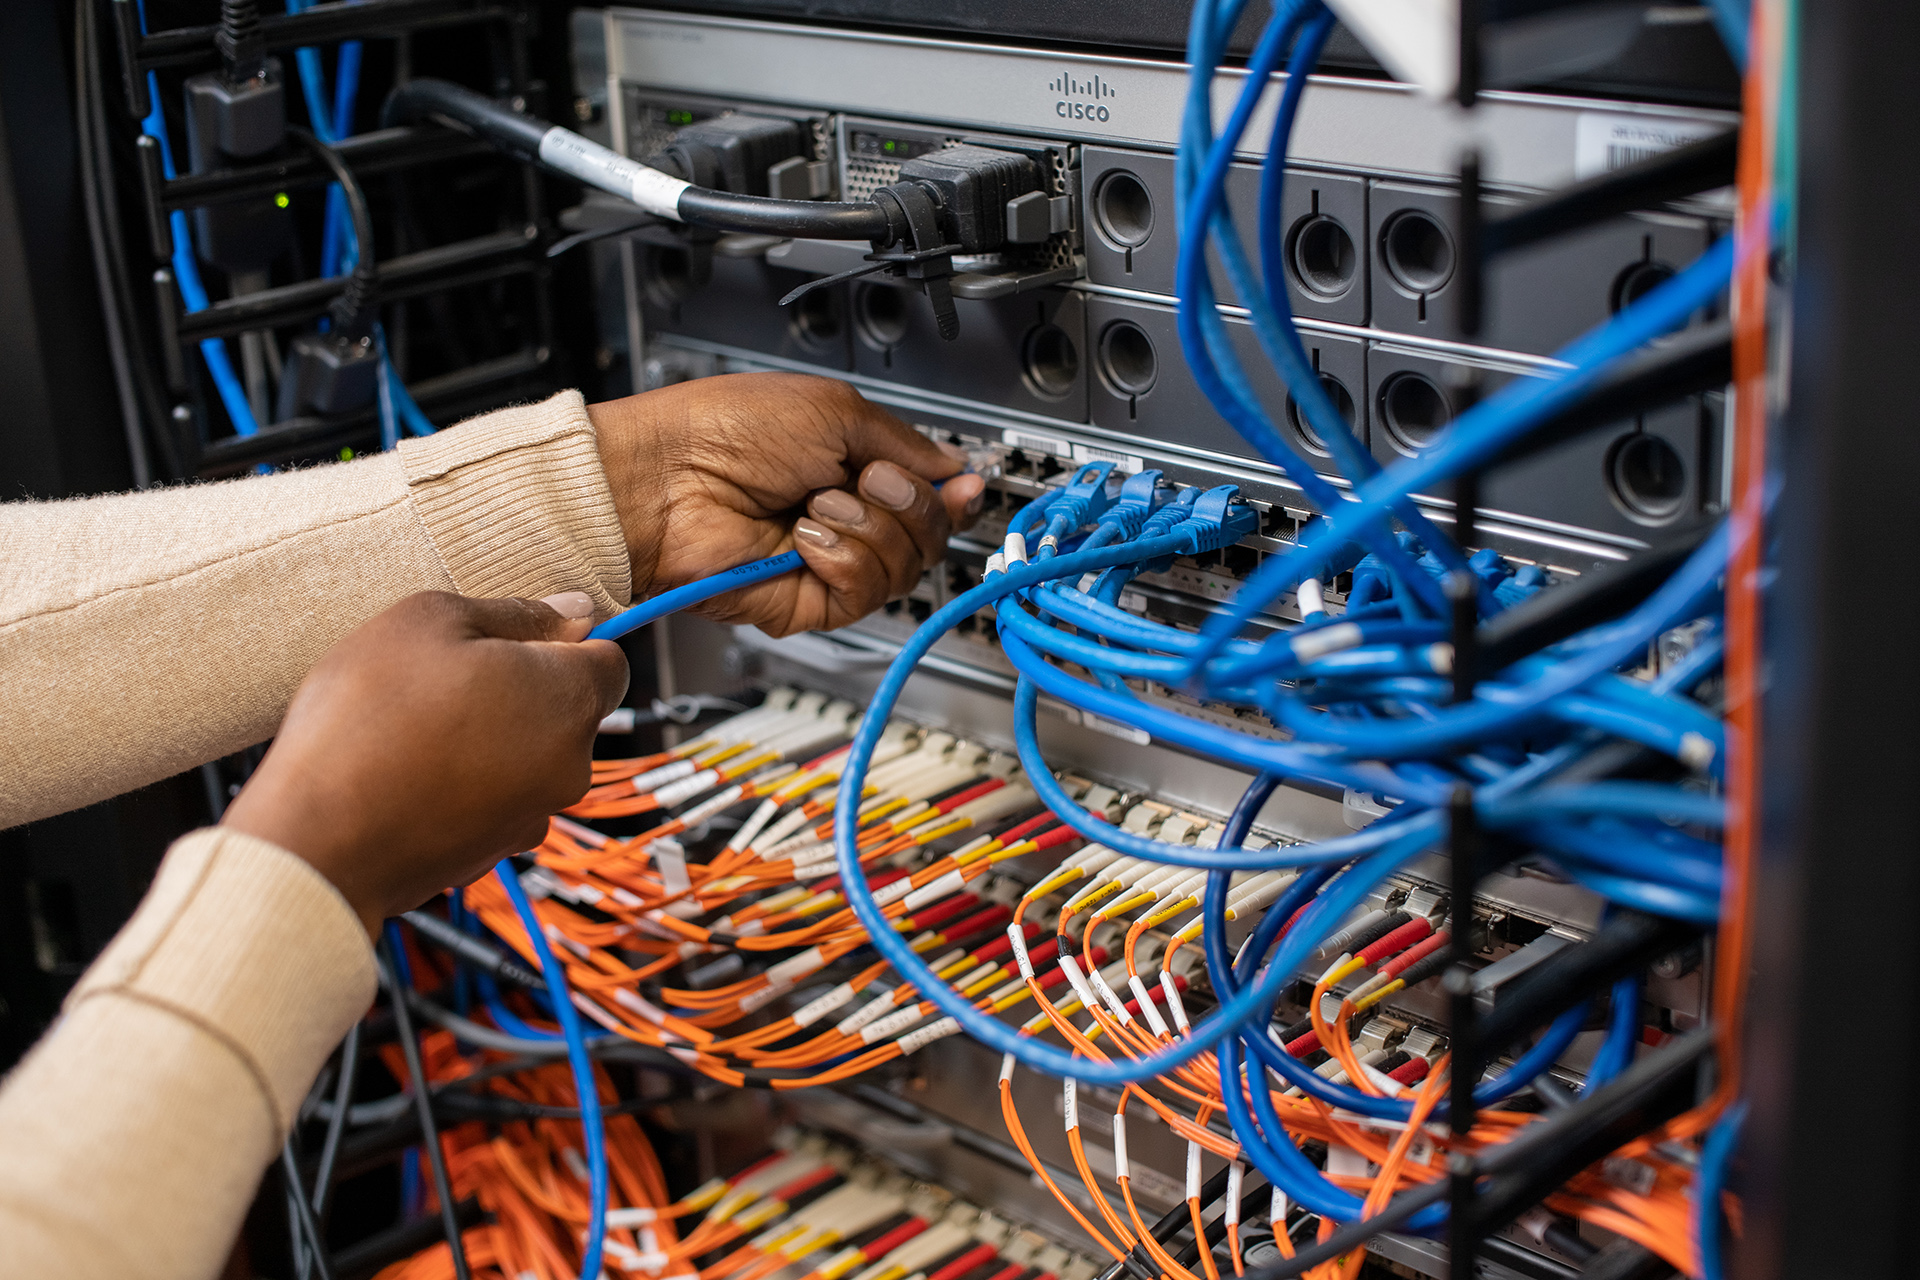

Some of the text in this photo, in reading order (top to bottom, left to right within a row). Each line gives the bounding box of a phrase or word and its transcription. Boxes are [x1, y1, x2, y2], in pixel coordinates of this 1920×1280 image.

[1056, 101, 1110, 122] CISCO
[731, 555, 792, 575] 0070 FEET
